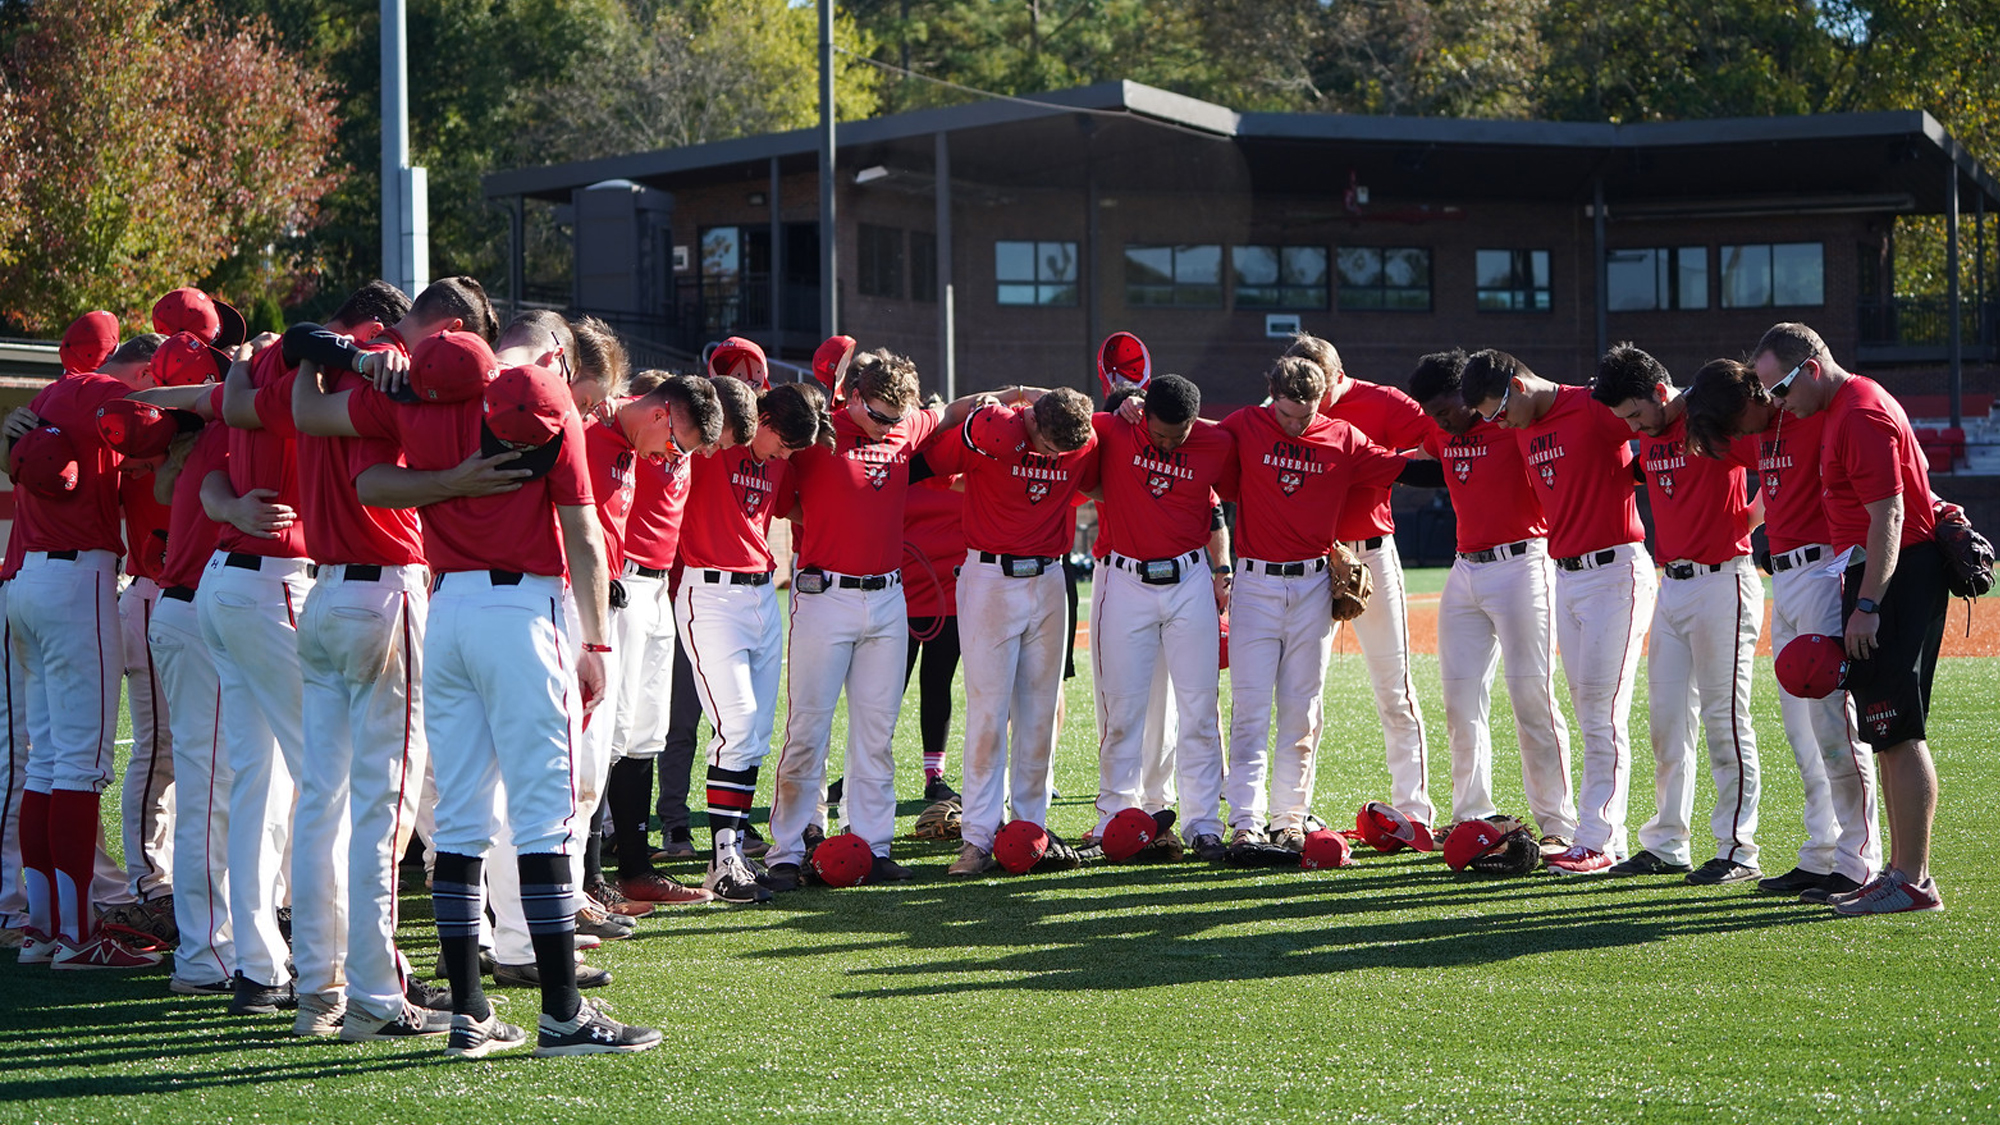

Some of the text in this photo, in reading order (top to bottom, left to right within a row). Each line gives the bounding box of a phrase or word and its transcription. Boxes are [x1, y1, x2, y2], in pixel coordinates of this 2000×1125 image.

[1273, 441, 1317, 462] GWU
[1443, 446, 1488, 458] BASEBALL
[1530, 431, 1557, 454] GWU
[848, 449, 904, 463] BASEBALL
[1021, 453, 1064, 470] GWU
[1143, 444, 1188, 468] GWU
[1263, 453, 1324, 474] BASEBALL
[1528, 446, 1565, 466] BASEBALL
[1646, 456, 1686, 471] BASEBALL
[739, 458, 769, 480] GWU
[1012, 465, 1068, 481] BASEBALL
[1133, 454, 1194, 480] BASEBALL
[731, 472, 772, 493] BASEBALL
[1865, 708, 1897, 723] BASEBALL
